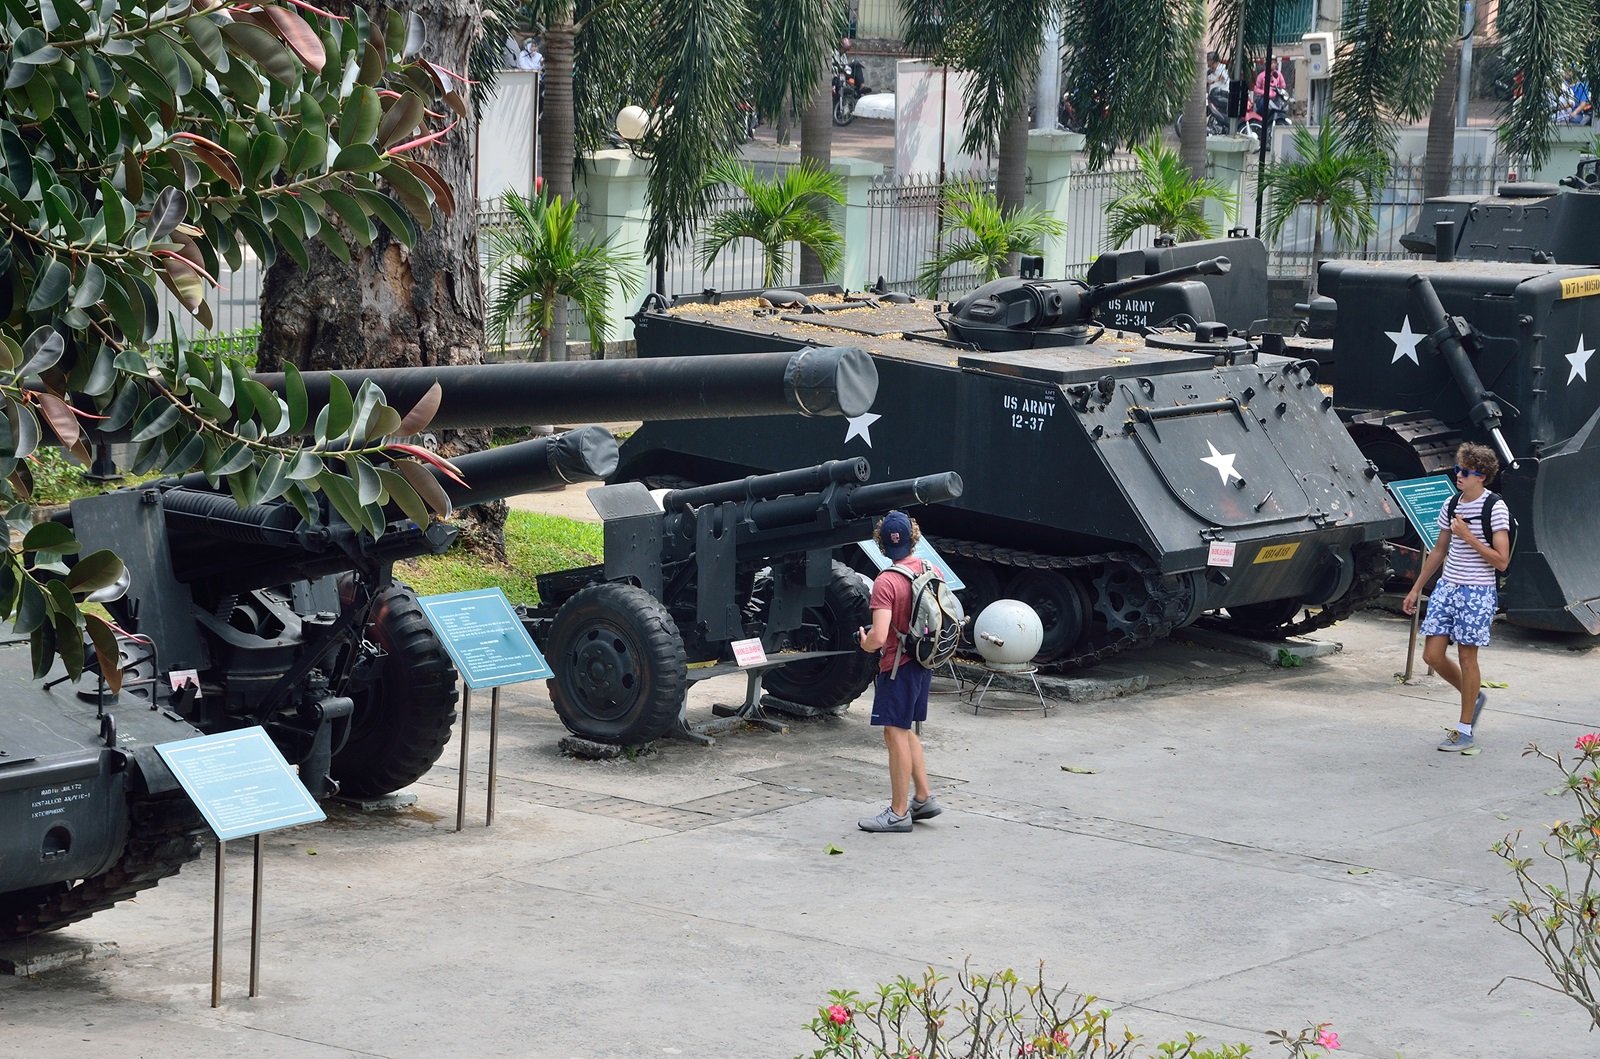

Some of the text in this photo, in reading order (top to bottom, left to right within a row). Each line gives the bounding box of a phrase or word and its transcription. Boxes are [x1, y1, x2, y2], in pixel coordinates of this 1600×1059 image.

[1109, 299, 1155, 313] US ARMY
[1115, 313, 1147, 327] 25-34
[1004, 395, 1056, 417] US ARMY
[1012, 413, 1045, 432] 12-37
